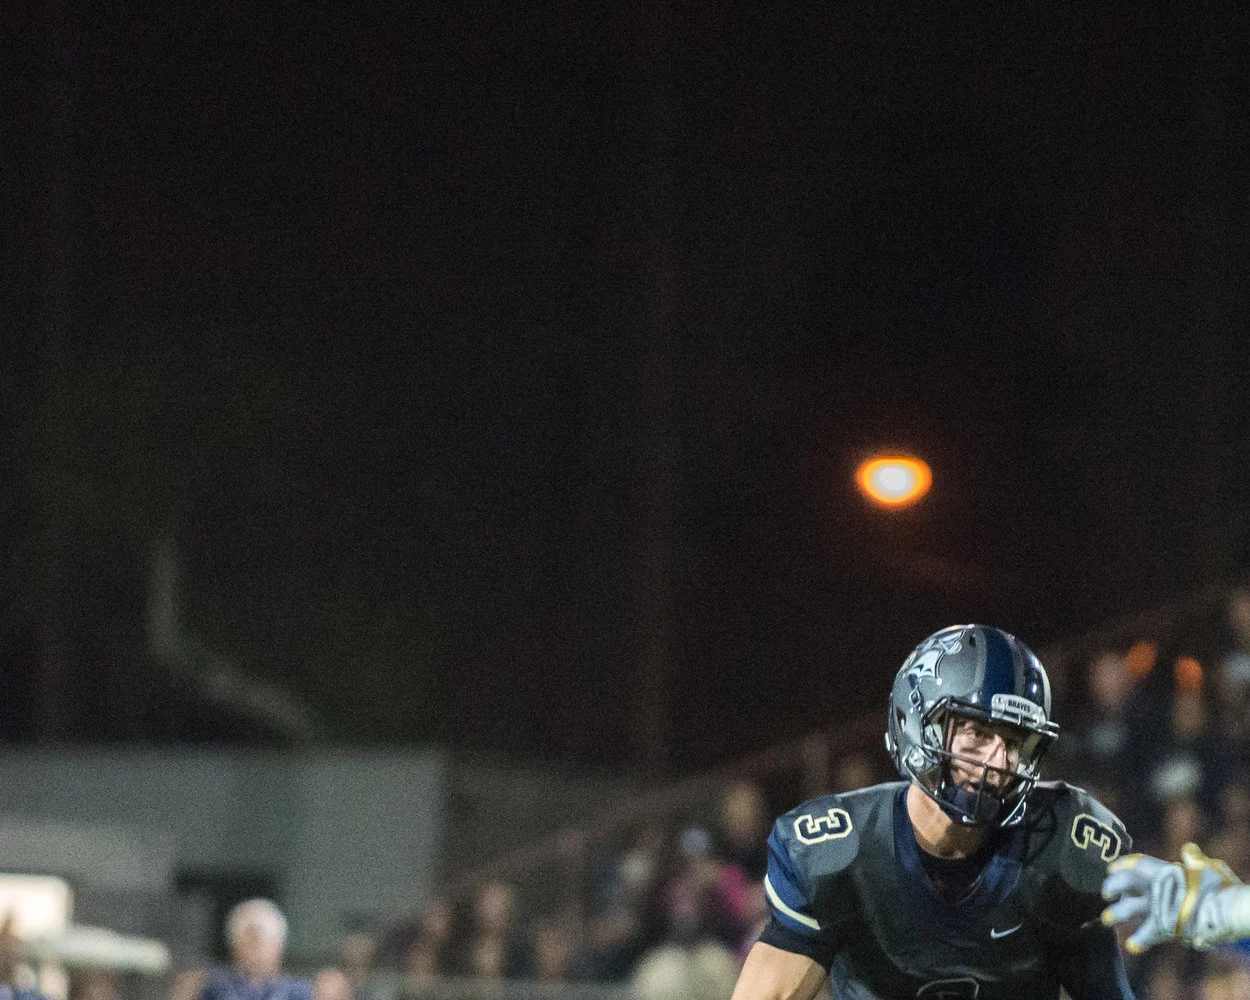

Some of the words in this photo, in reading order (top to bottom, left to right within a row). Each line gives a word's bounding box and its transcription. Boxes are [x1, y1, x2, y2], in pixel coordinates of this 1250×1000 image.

[1007, 699, 1031, 714] BRAVES
[793, 807, 854, 846] 3
[1070, 813, 1122, 862] 3
